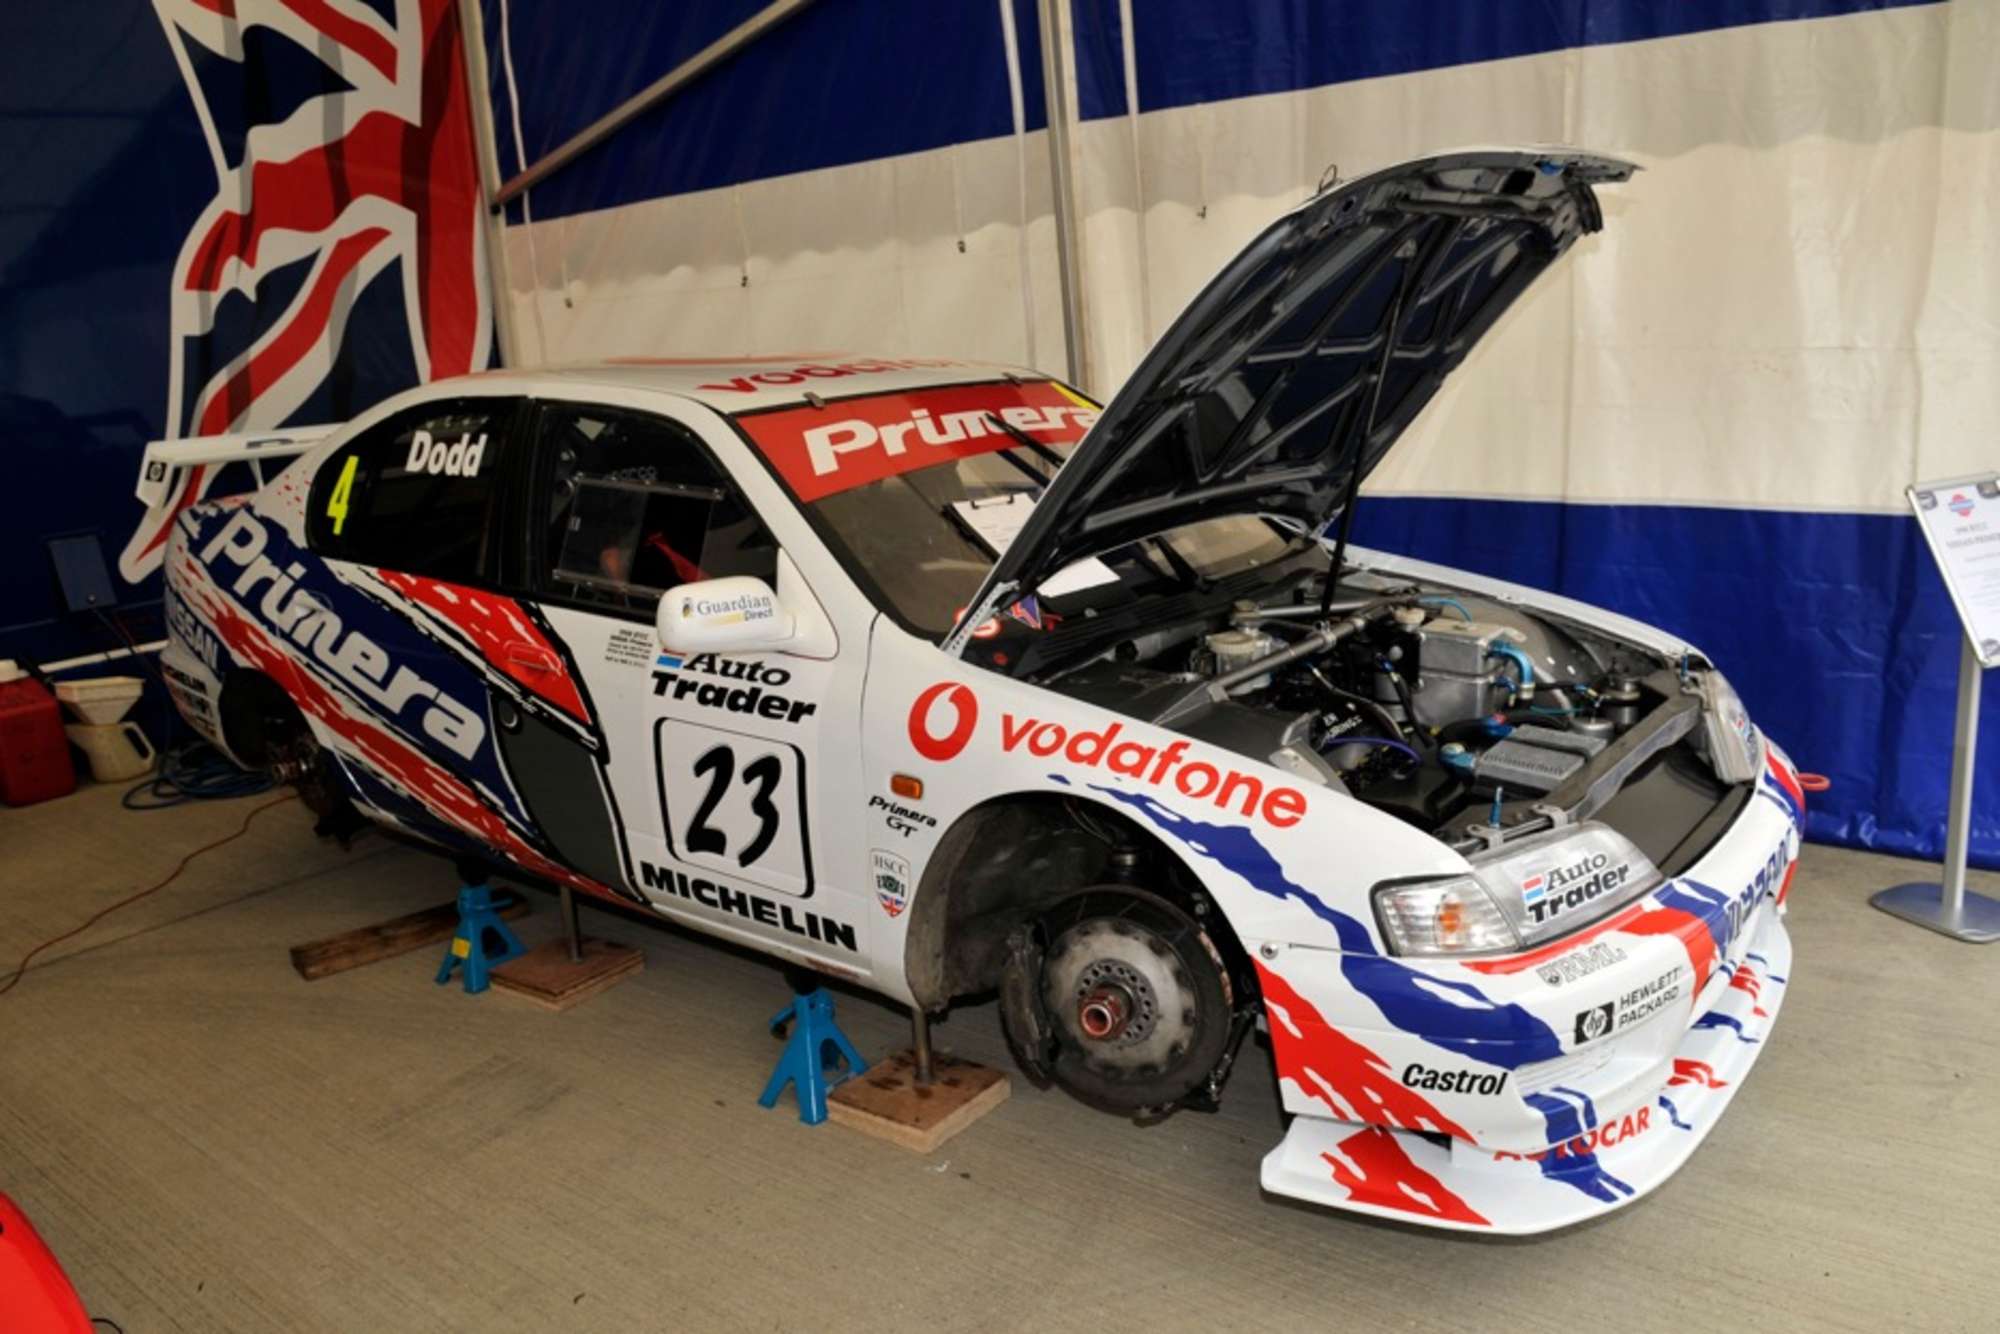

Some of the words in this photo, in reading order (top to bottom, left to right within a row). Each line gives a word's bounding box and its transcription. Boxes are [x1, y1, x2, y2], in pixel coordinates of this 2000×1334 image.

[406, 430, 488, 477] Dodd
[327, 455, 359, 535] 4
[697, 594, 772, 616] Guardian
[744, 608, 773, 622] Direct
[200, 508, 486, 761] Primera
[683, 652, 791, 686] Auto
[651, 671, 817, 724] Trader
[1001, 712, 1307, 828] vodafone
[685, 744, 782, 868] 23
[868, 795, 937, 828] Primera
[886, 815, 918, 838] GT
[1528, 863, 1629, 923] Trader
[1546, 853, 1607, 892] Auto
[640, 860, 858, 951] MICHELIN
[1618, 985, 1680, 1028] PACKARD
[1620, 967, 1680, 1010] HEWLETT
[1402, 1063, 1507, 1096] Castrol
[1493, 1106, 1650, 1162] TOCAR
